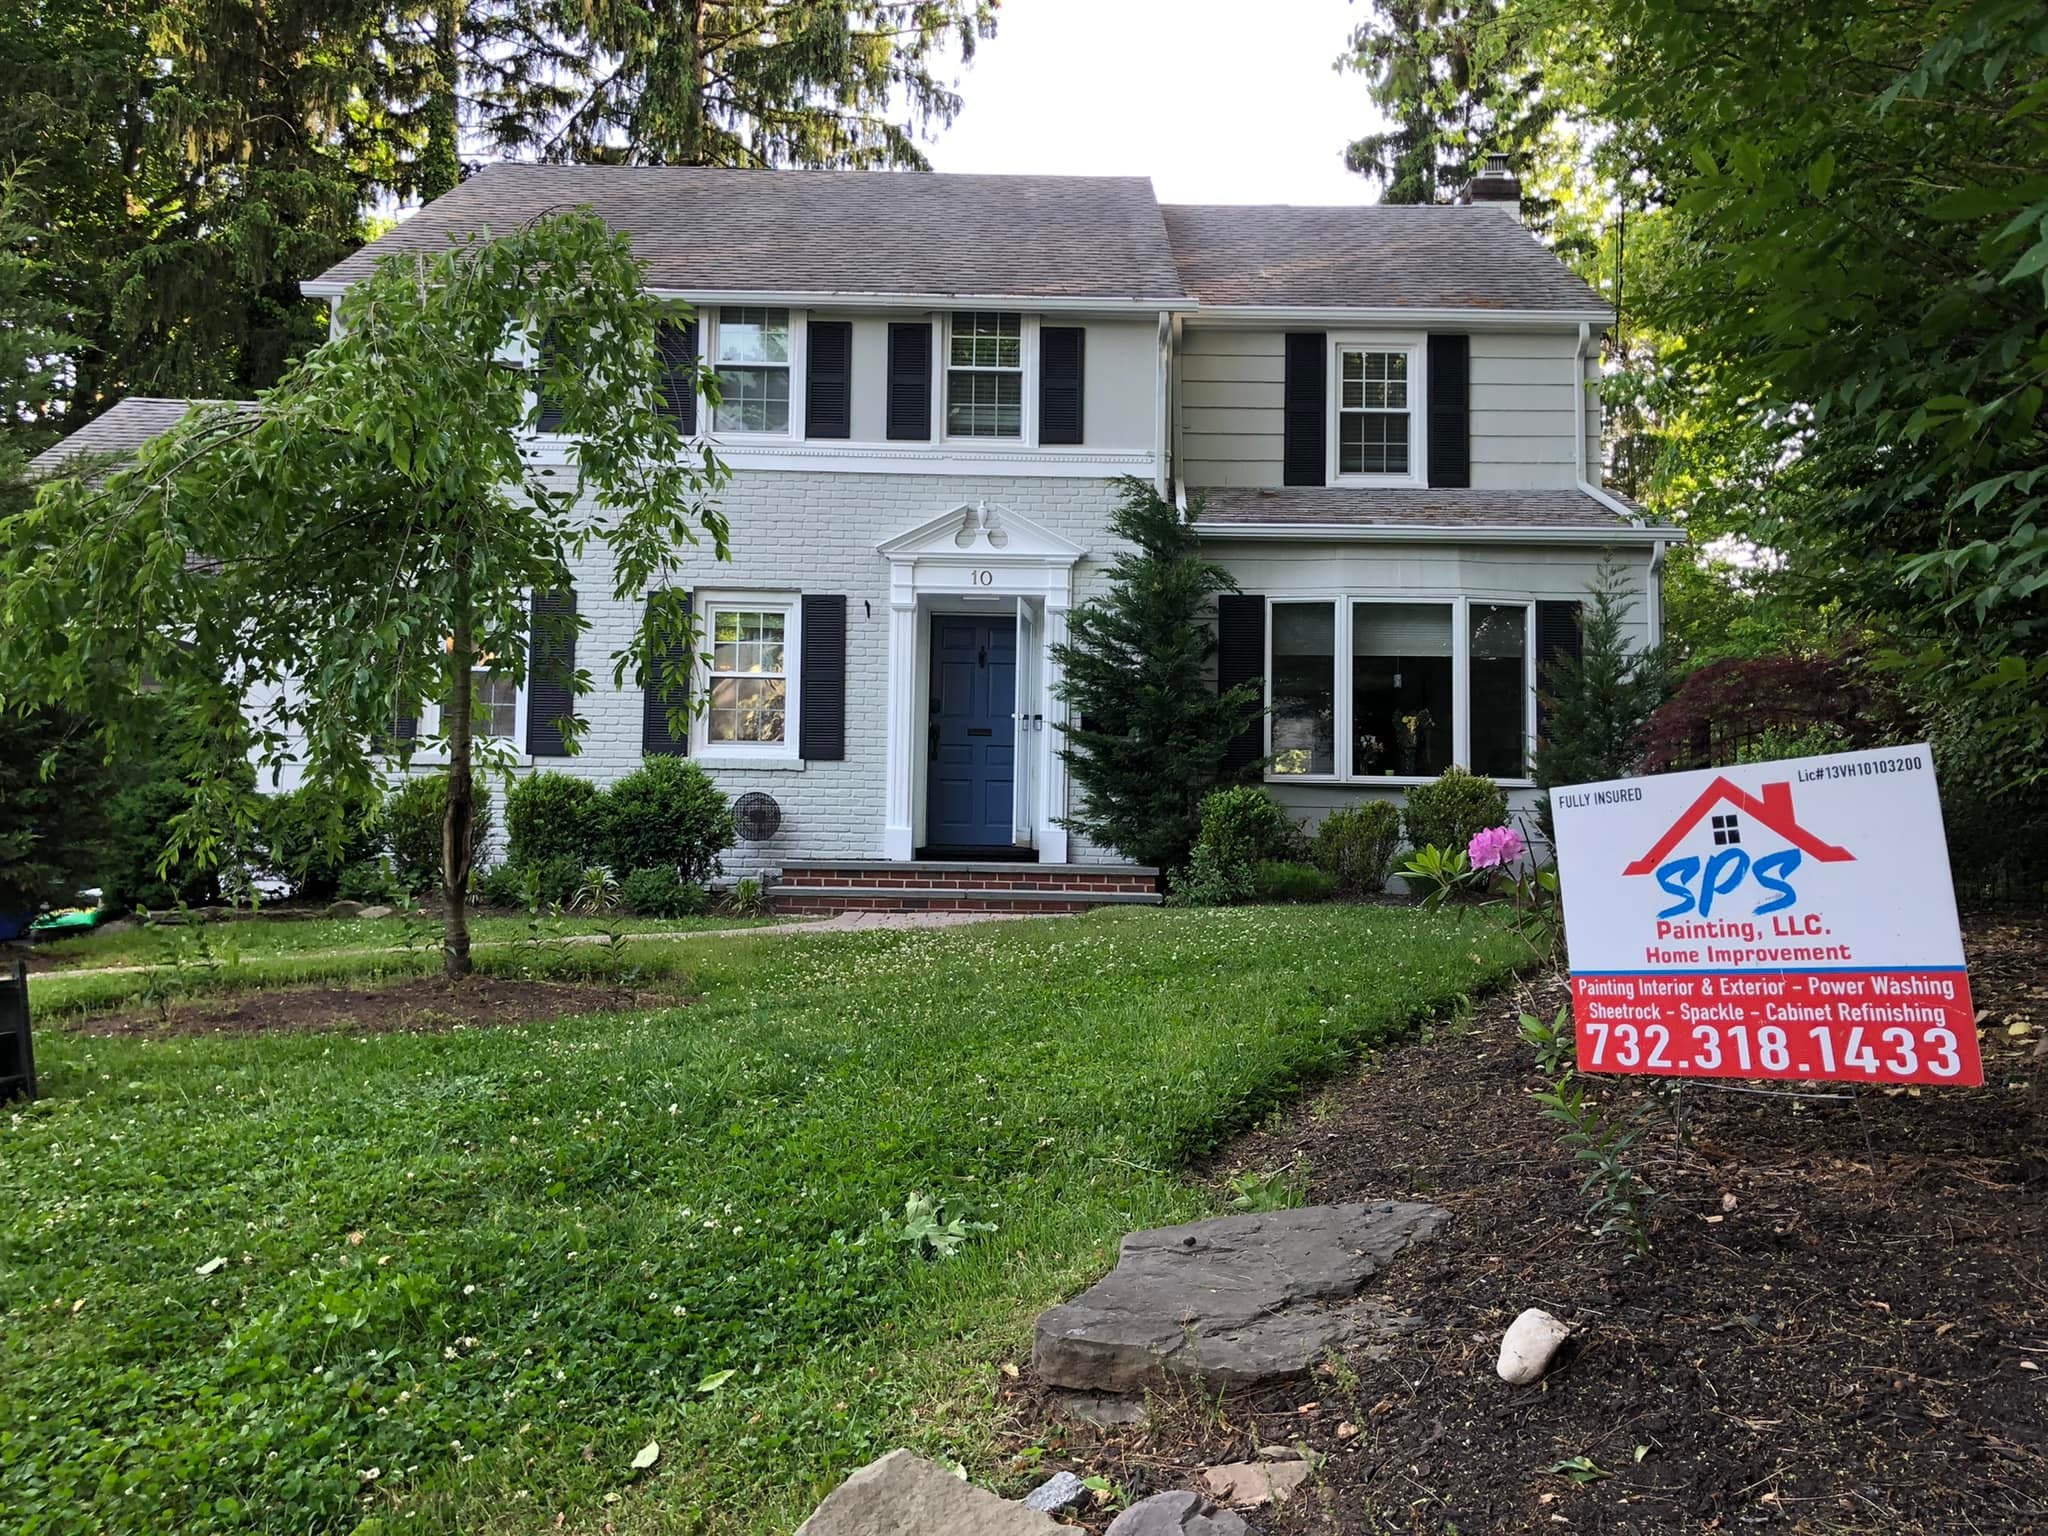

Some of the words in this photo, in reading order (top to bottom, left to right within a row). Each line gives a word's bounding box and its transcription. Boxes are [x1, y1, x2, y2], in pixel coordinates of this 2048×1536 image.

[971, 569, 993, 586] 10
[1798, 756, 1922, 782] Lic#13VH10103200
[1559, 793, 1591, 809] FULLY
[1594, 787, 1642, 805] INSURED
[1656, 847, 1802, 919] SPS
[1656, 919, 1763, 942] Painting,
[1772, 914, 1831, 937] LLC.
[1646, 946, 1699, 964] Home
[1707, 944, 1852, 966] Improvement
[1578, 979, 1635, 1000] Painting
[1639, 978, 1694, 996] Interior
[1702, 978, 1713, 996] &
[1720, 977, 1785, 996] Exterior
[1808, 977, 1865, 995] Power
[1871, 976, 1955, 999] Washing
[1589, 1002, 1661, 1020] Sheetrock
[1680, 1002, 1744, 1024] Spackle
[1766, 1003, 1833, 1022] Cabinet
[1838, 1003, 1946, 1027] Refinishing
[1586, 1023, 1961, 1077] 732.318.1433
